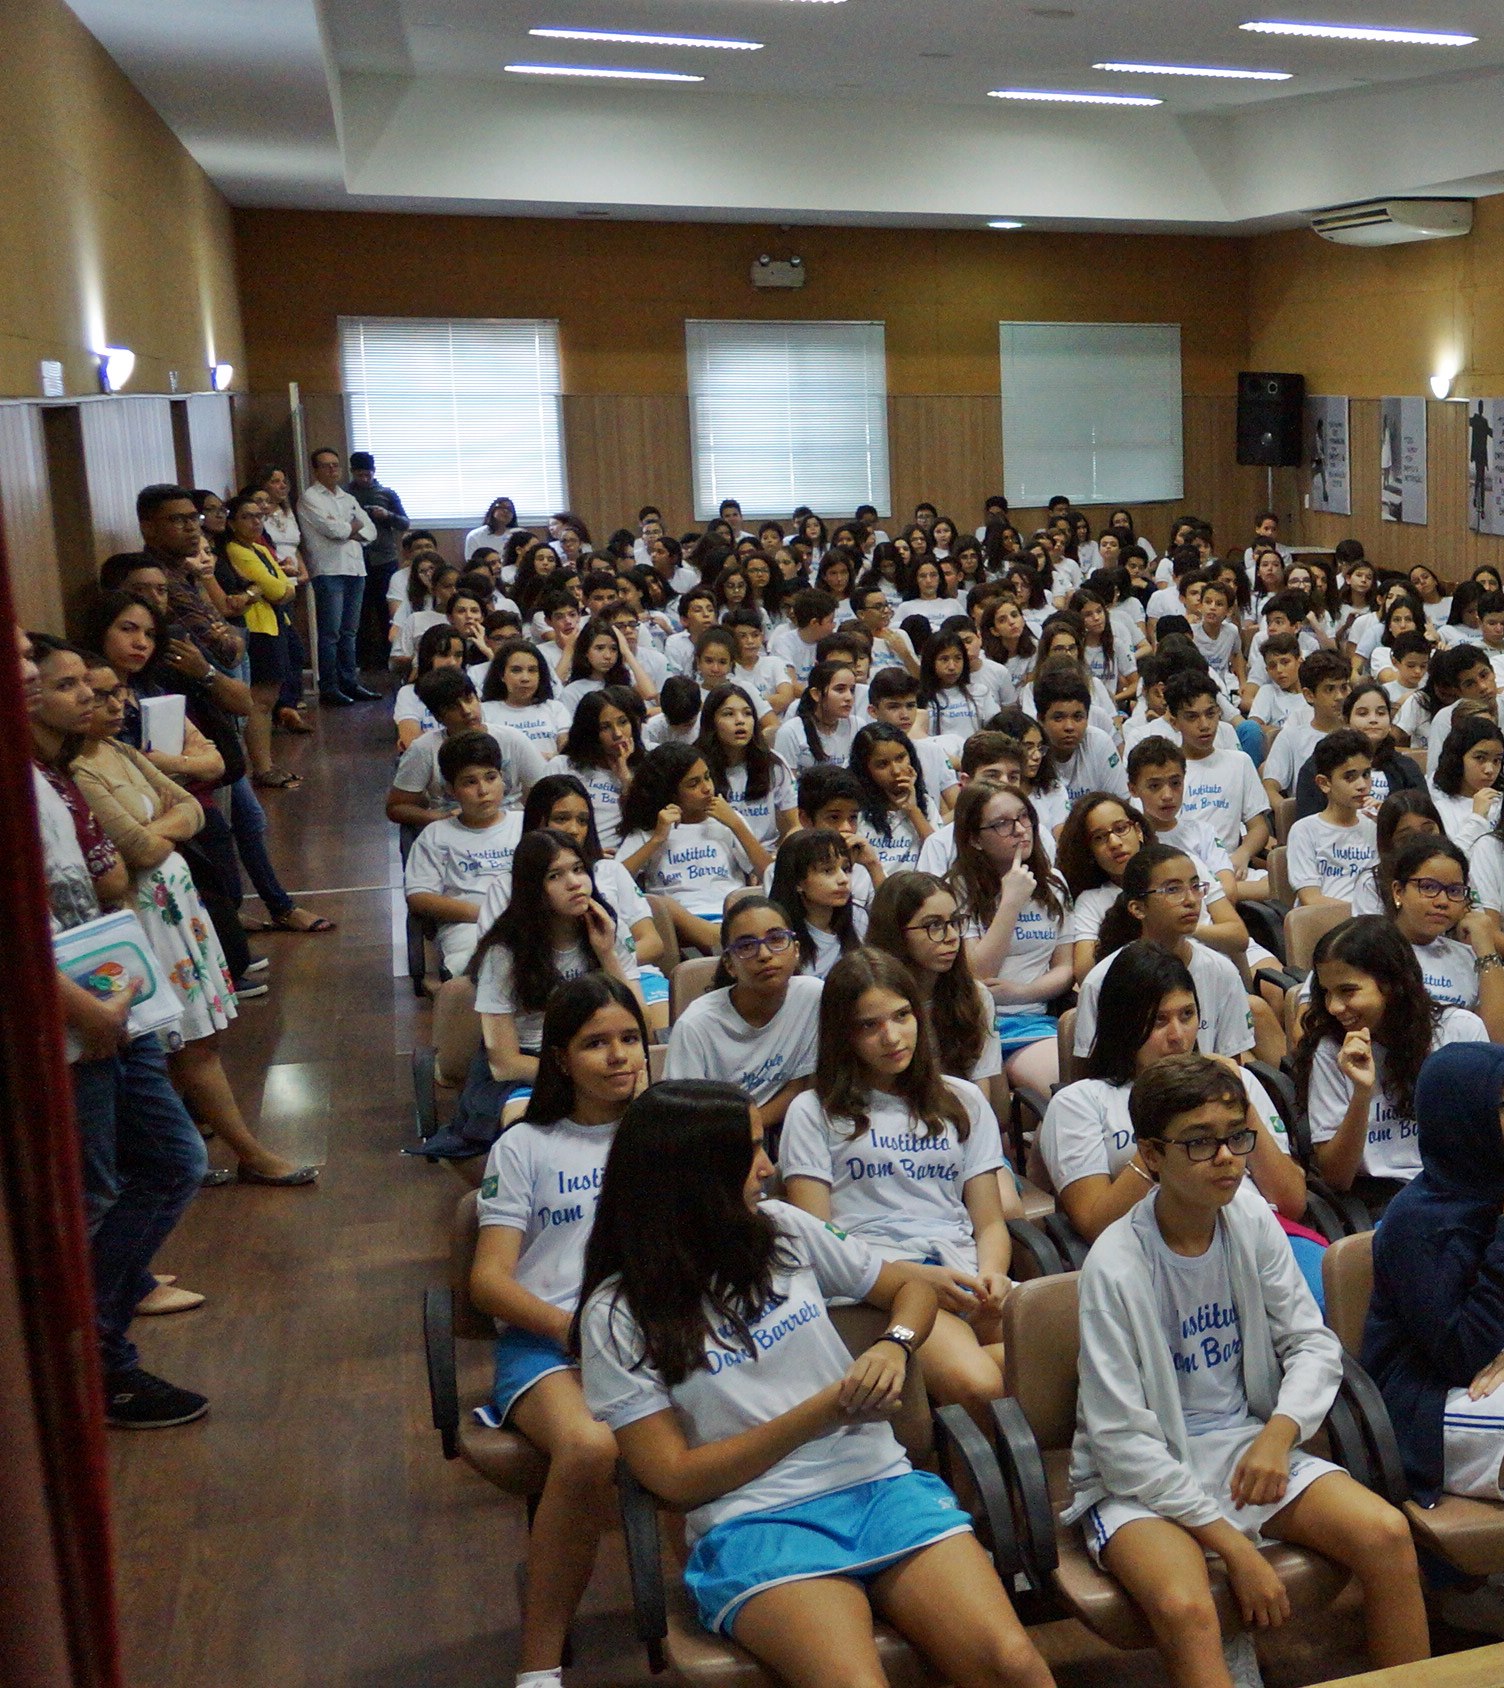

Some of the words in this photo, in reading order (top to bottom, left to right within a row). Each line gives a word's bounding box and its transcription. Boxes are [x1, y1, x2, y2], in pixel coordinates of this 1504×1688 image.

[667, 844, 718, 865] Instituto
[1367, 1126, 1392, 1145] om
[846, 1157, 895, 1181] Dom
[538, 1204, 584, 1229] Dom
